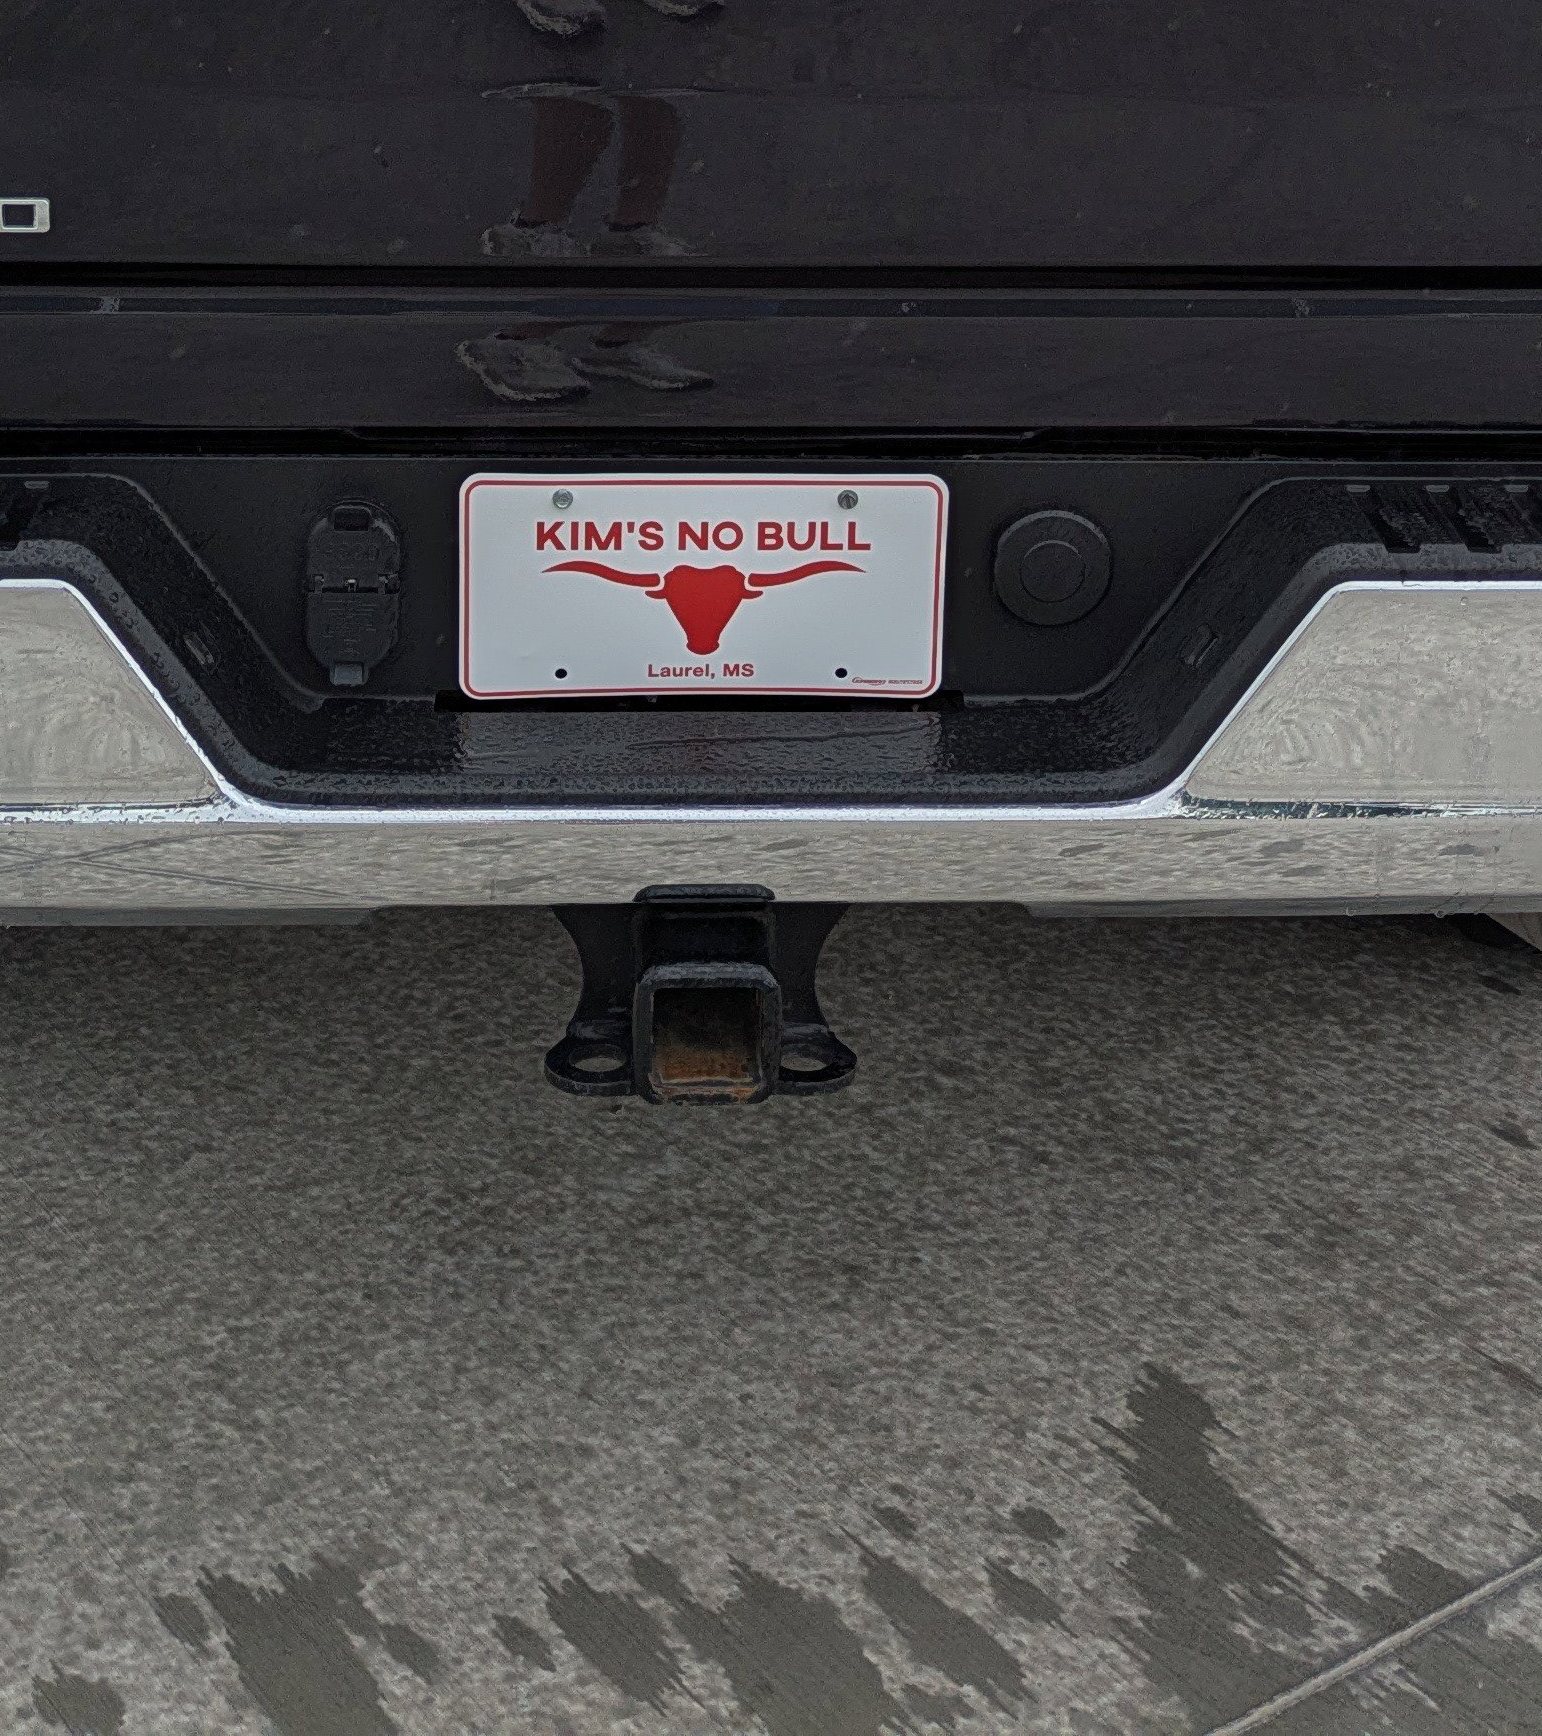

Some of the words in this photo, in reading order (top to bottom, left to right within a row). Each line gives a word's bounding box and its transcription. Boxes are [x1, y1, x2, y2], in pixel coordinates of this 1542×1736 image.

[536, 521, 664, 552] KIM'S
[678, 521, 744, 552] NO
[757, 521, 871, 552] BULL
[647, 663, 716, 680] Laurel,
[722, 663, 755, 678] MS
